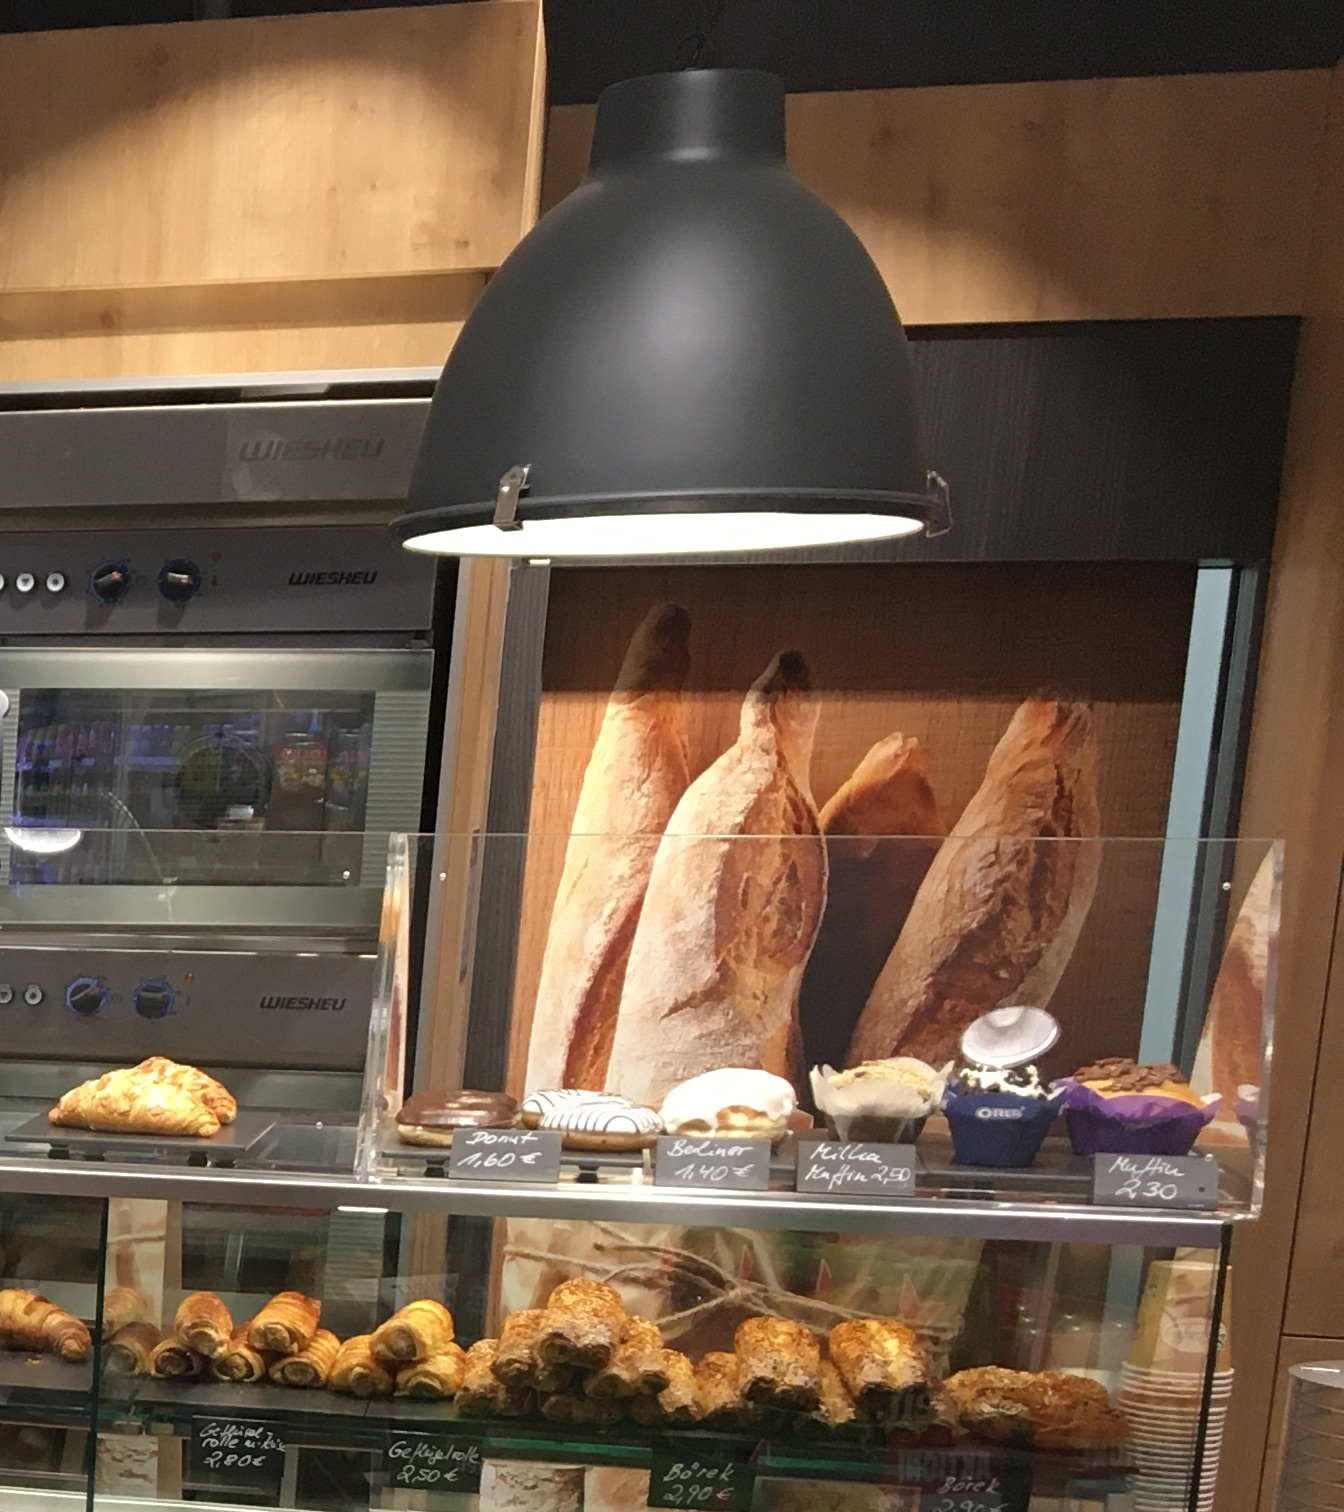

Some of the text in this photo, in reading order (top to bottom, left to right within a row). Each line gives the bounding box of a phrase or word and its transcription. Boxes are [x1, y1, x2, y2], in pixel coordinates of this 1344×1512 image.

[239, 438, 385, 463] WIESHEU
[288, 570, 378, 586] WIESHEU
[259, 996, 346, 1011] WIESHEU
[465, 1131, 539, 1146] Donut
[457, 1151, 516, 1169] 1,60
[1109, 1156, 1185, 1179] Muffin
[673, 1163, 730, 1181] 1,40
[805, 1165, 912, 1191] Muffin 2,50
[397, 1465, 441, 1483] 2,50
[664, 1462, 735, 1482] Börek
[937, 1476, 1001, 1494] Börek
[663, 1484, 713, 1505] 2,90
